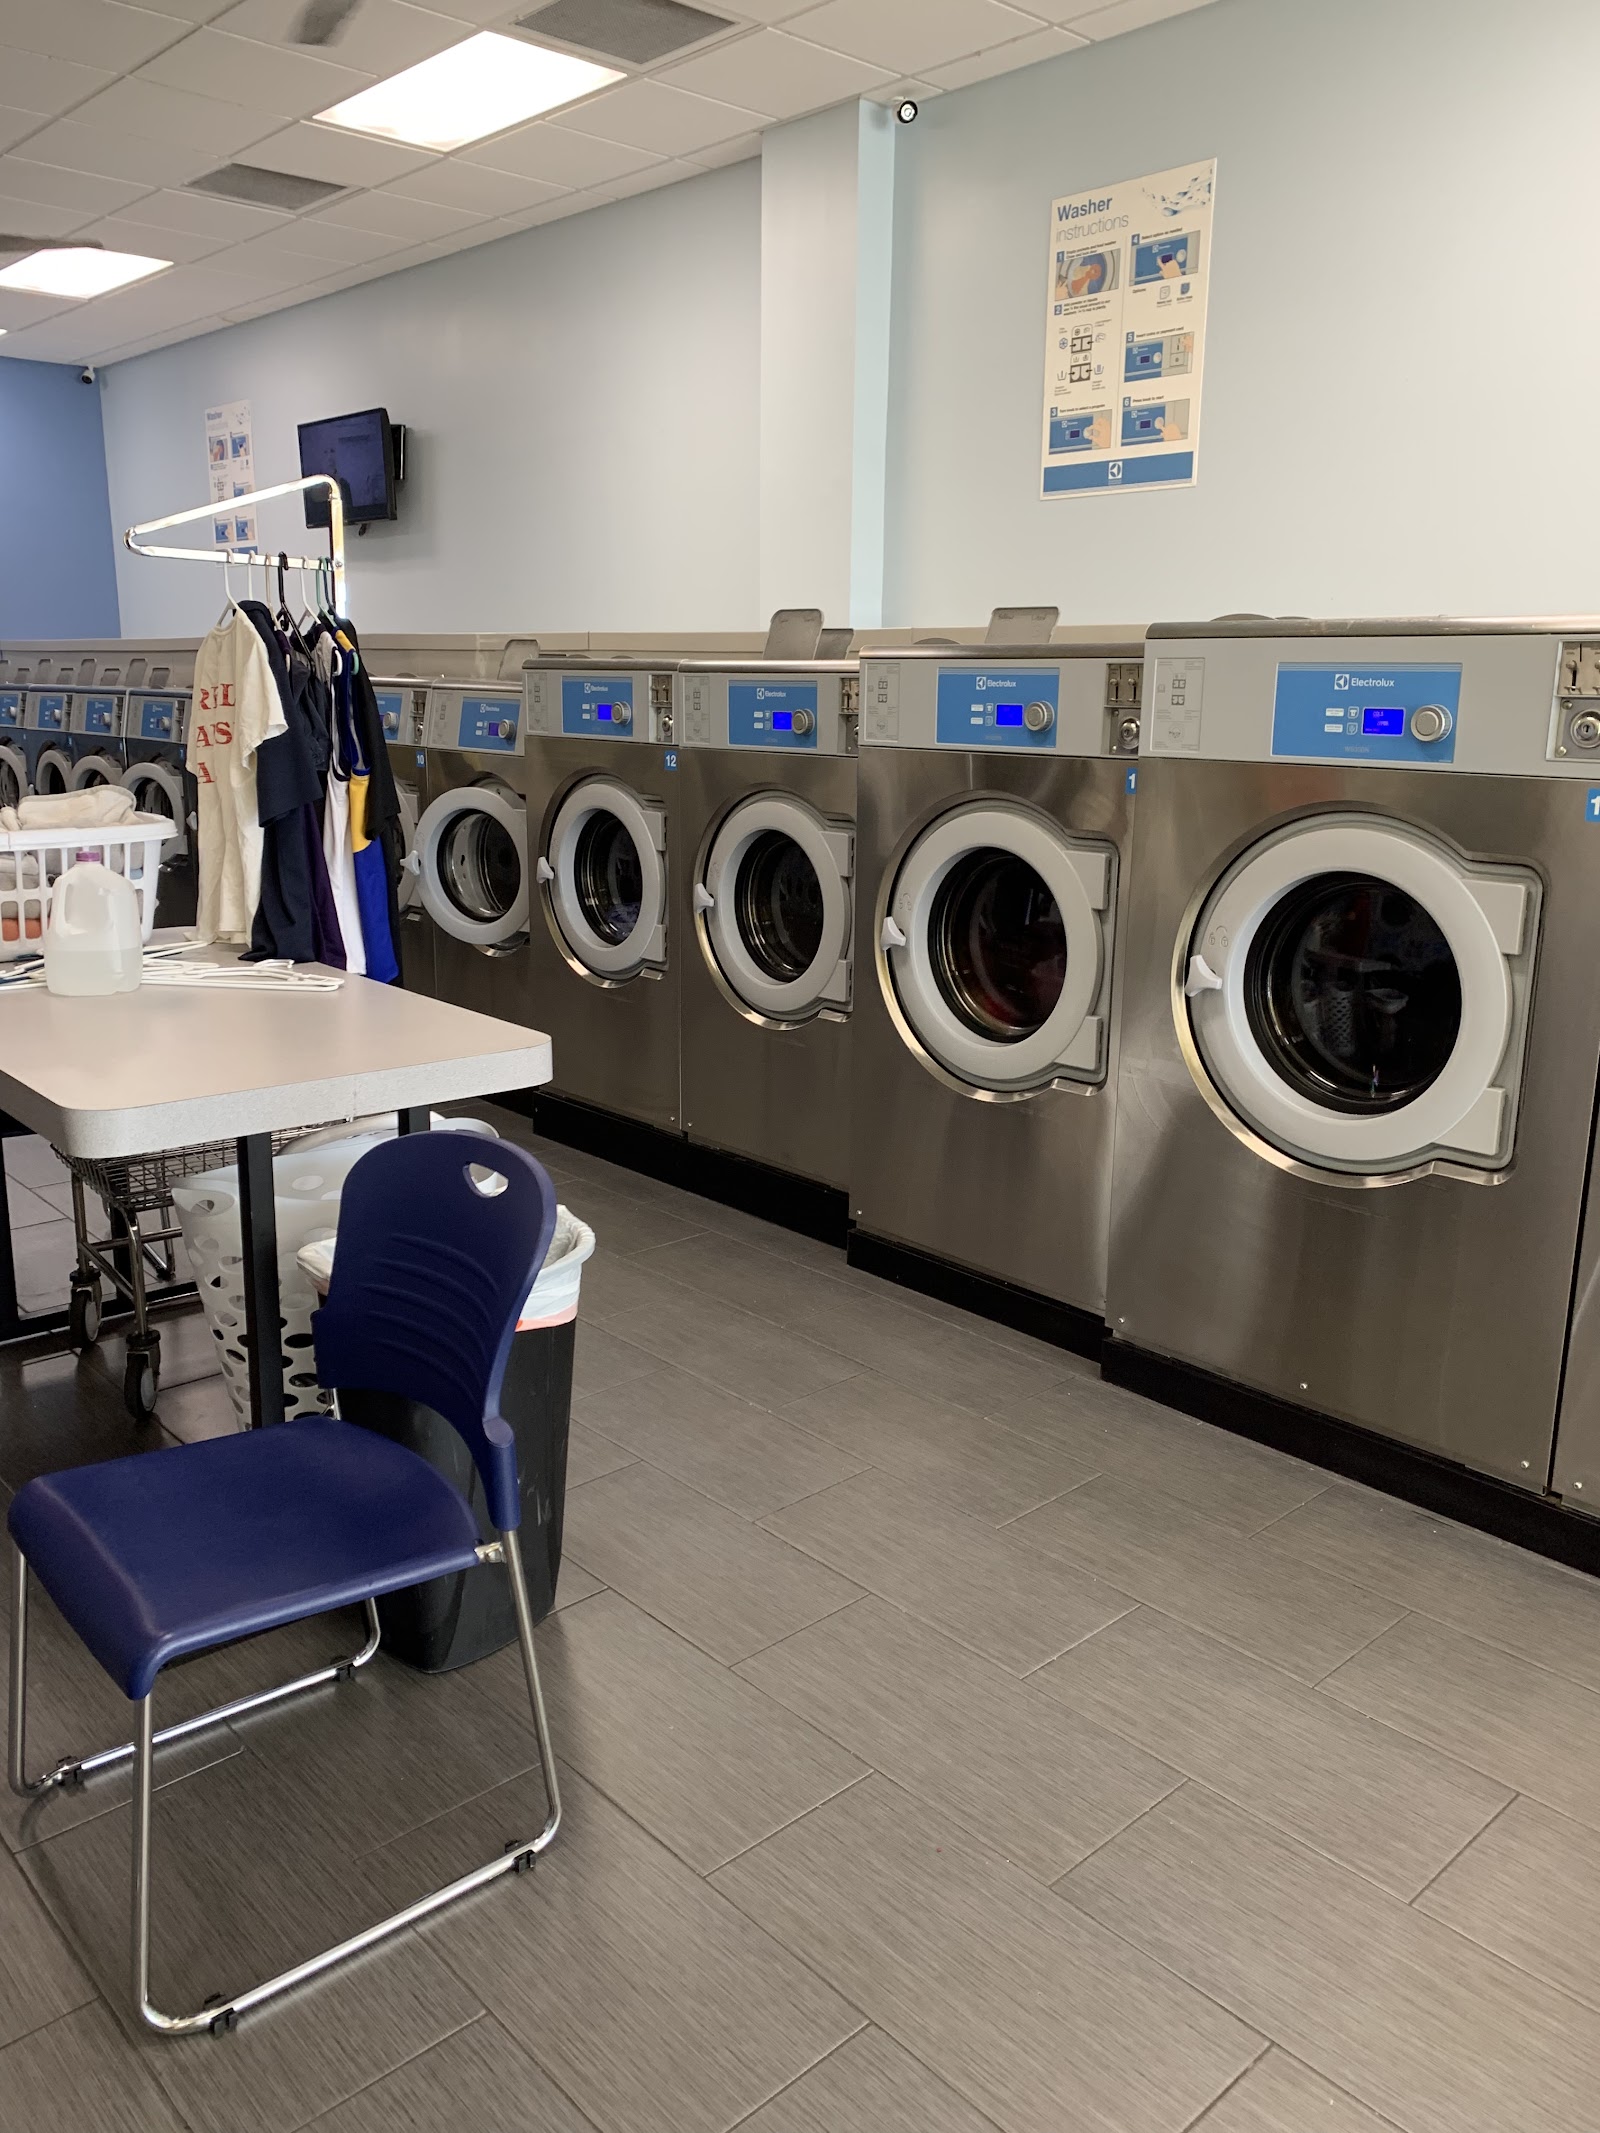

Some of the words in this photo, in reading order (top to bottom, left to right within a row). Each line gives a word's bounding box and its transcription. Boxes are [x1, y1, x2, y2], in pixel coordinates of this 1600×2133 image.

[1057, 197, 1113, 222] Washer
[1056, 214, 1129, 243] instructions
[1132, 235, 1138, 244] 4
[1055, 305, 1061, 315] 2
[1126, 333, 1133, 342] 5
[1124, 398, 1130, 407] 6
[1051, 408, 1057, 417] 3
[987, 679, 1017, 688] Electrolux
[1351, 677, 1395, 687] Electrolux
[764, 690, 787, 698] Electrolux
[416, 754, 425, 765] 10
[665, 754, 677, 768] 12
